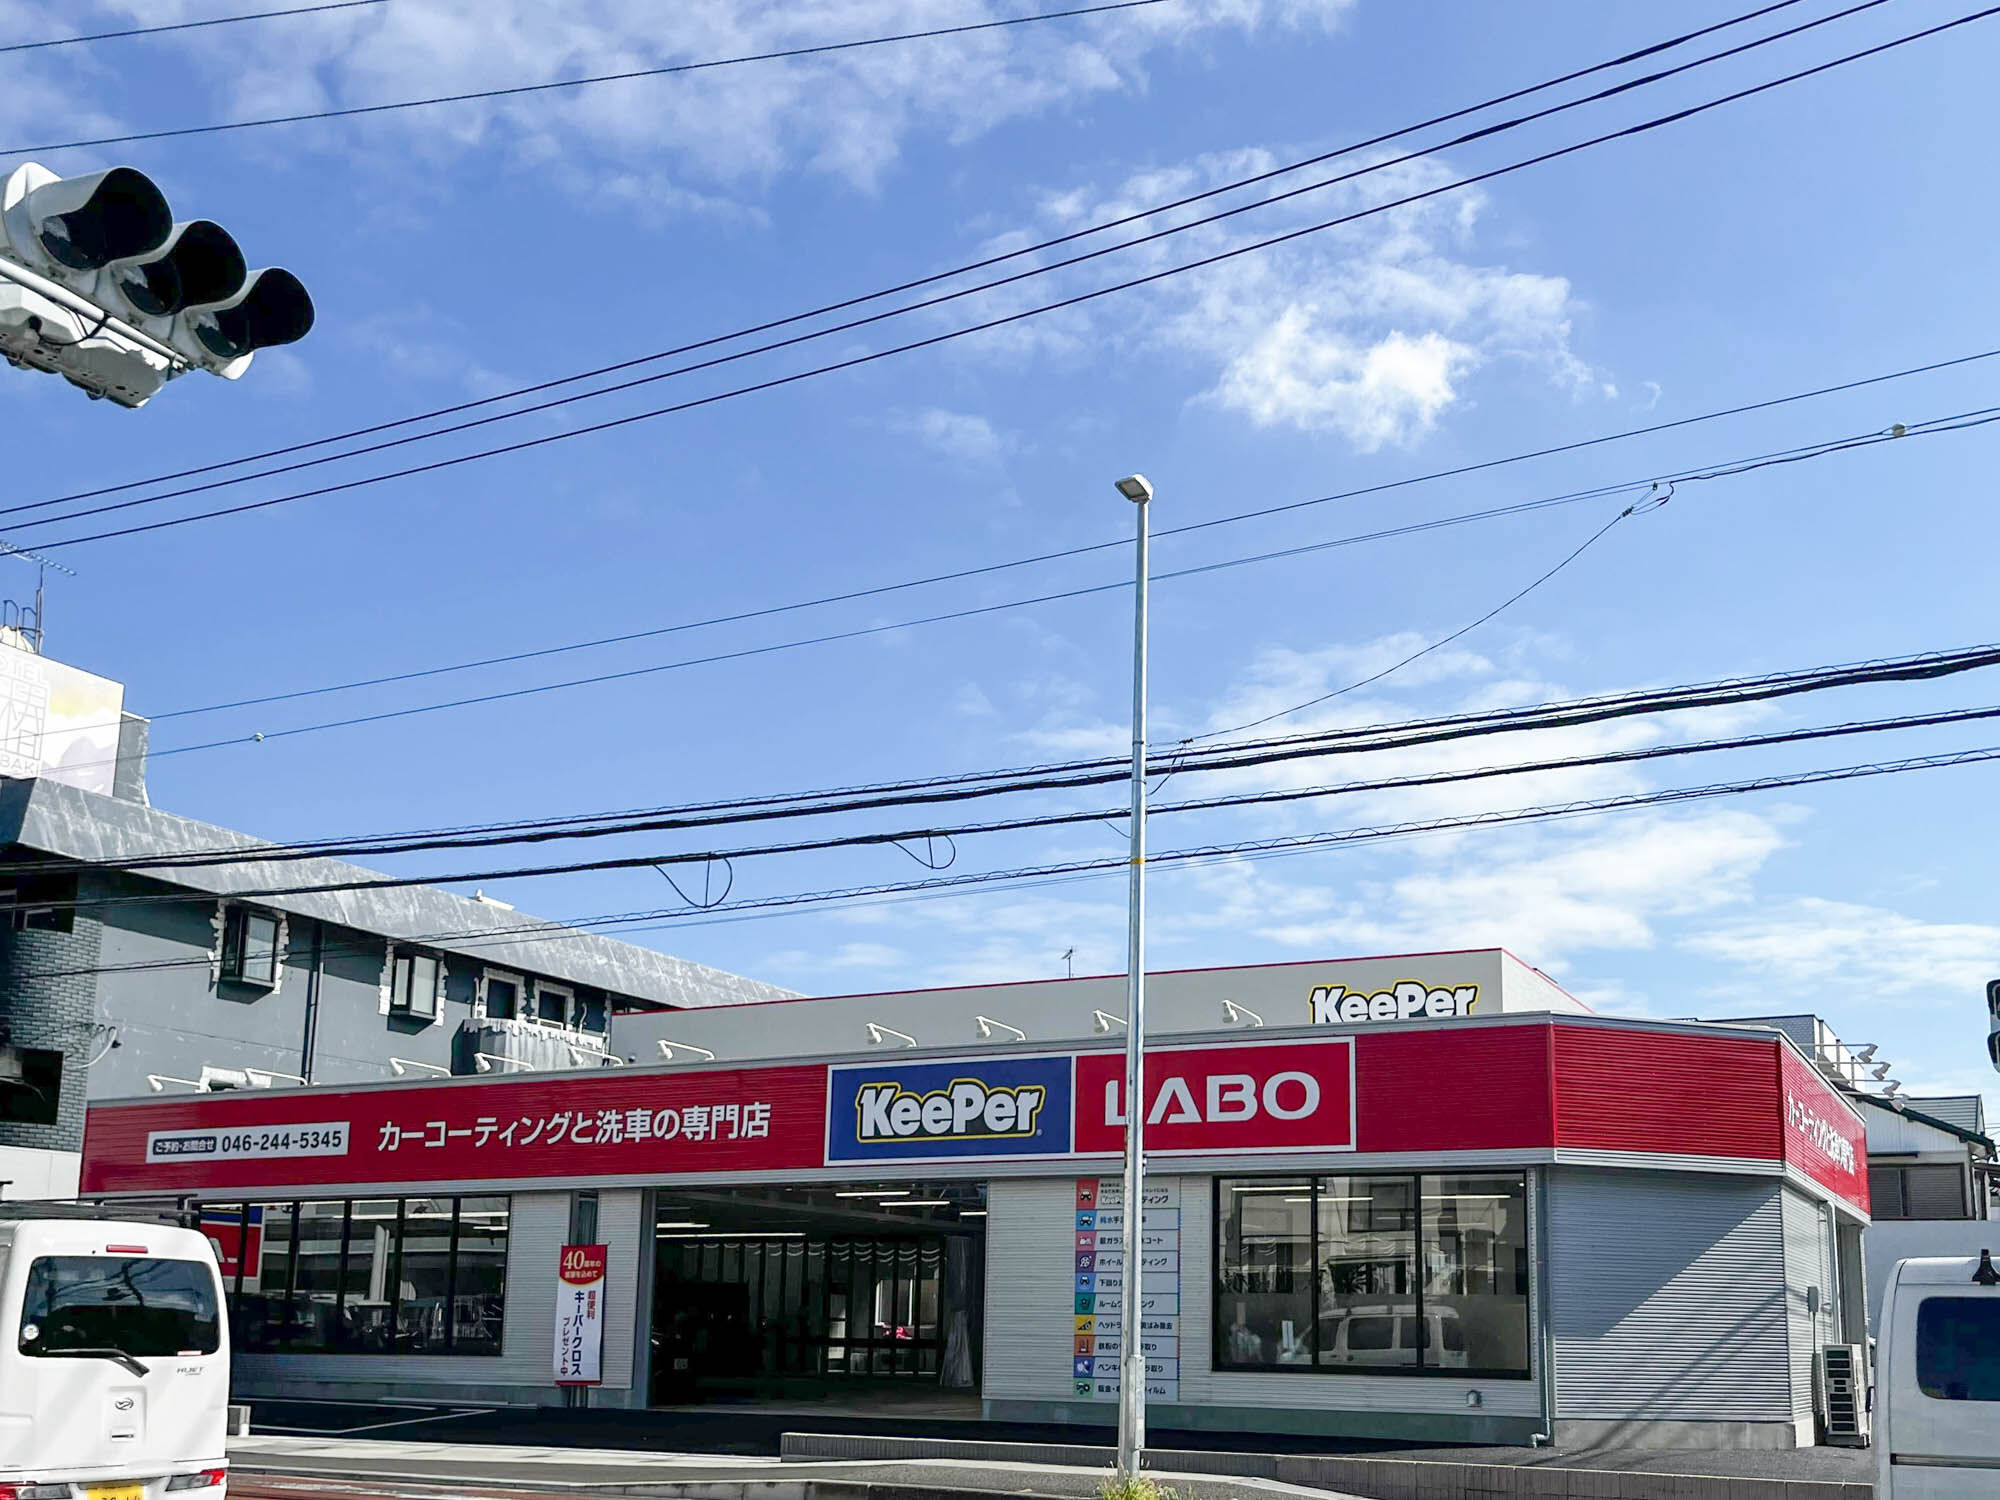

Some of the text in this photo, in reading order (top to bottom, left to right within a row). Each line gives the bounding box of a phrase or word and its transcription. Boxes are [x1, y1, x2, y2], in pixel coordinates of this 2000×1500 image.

[1312, 981, 1478, 1023] KeePer
[377, 1102, 772, 1153] カーコーティングと洗車の専門店
[858, 1070, 1321, 1140] KeePer LABO
[221, 1130, 343, 1152] 046-244-5345
[572, 1290, 585, 1376] キーパークロス
